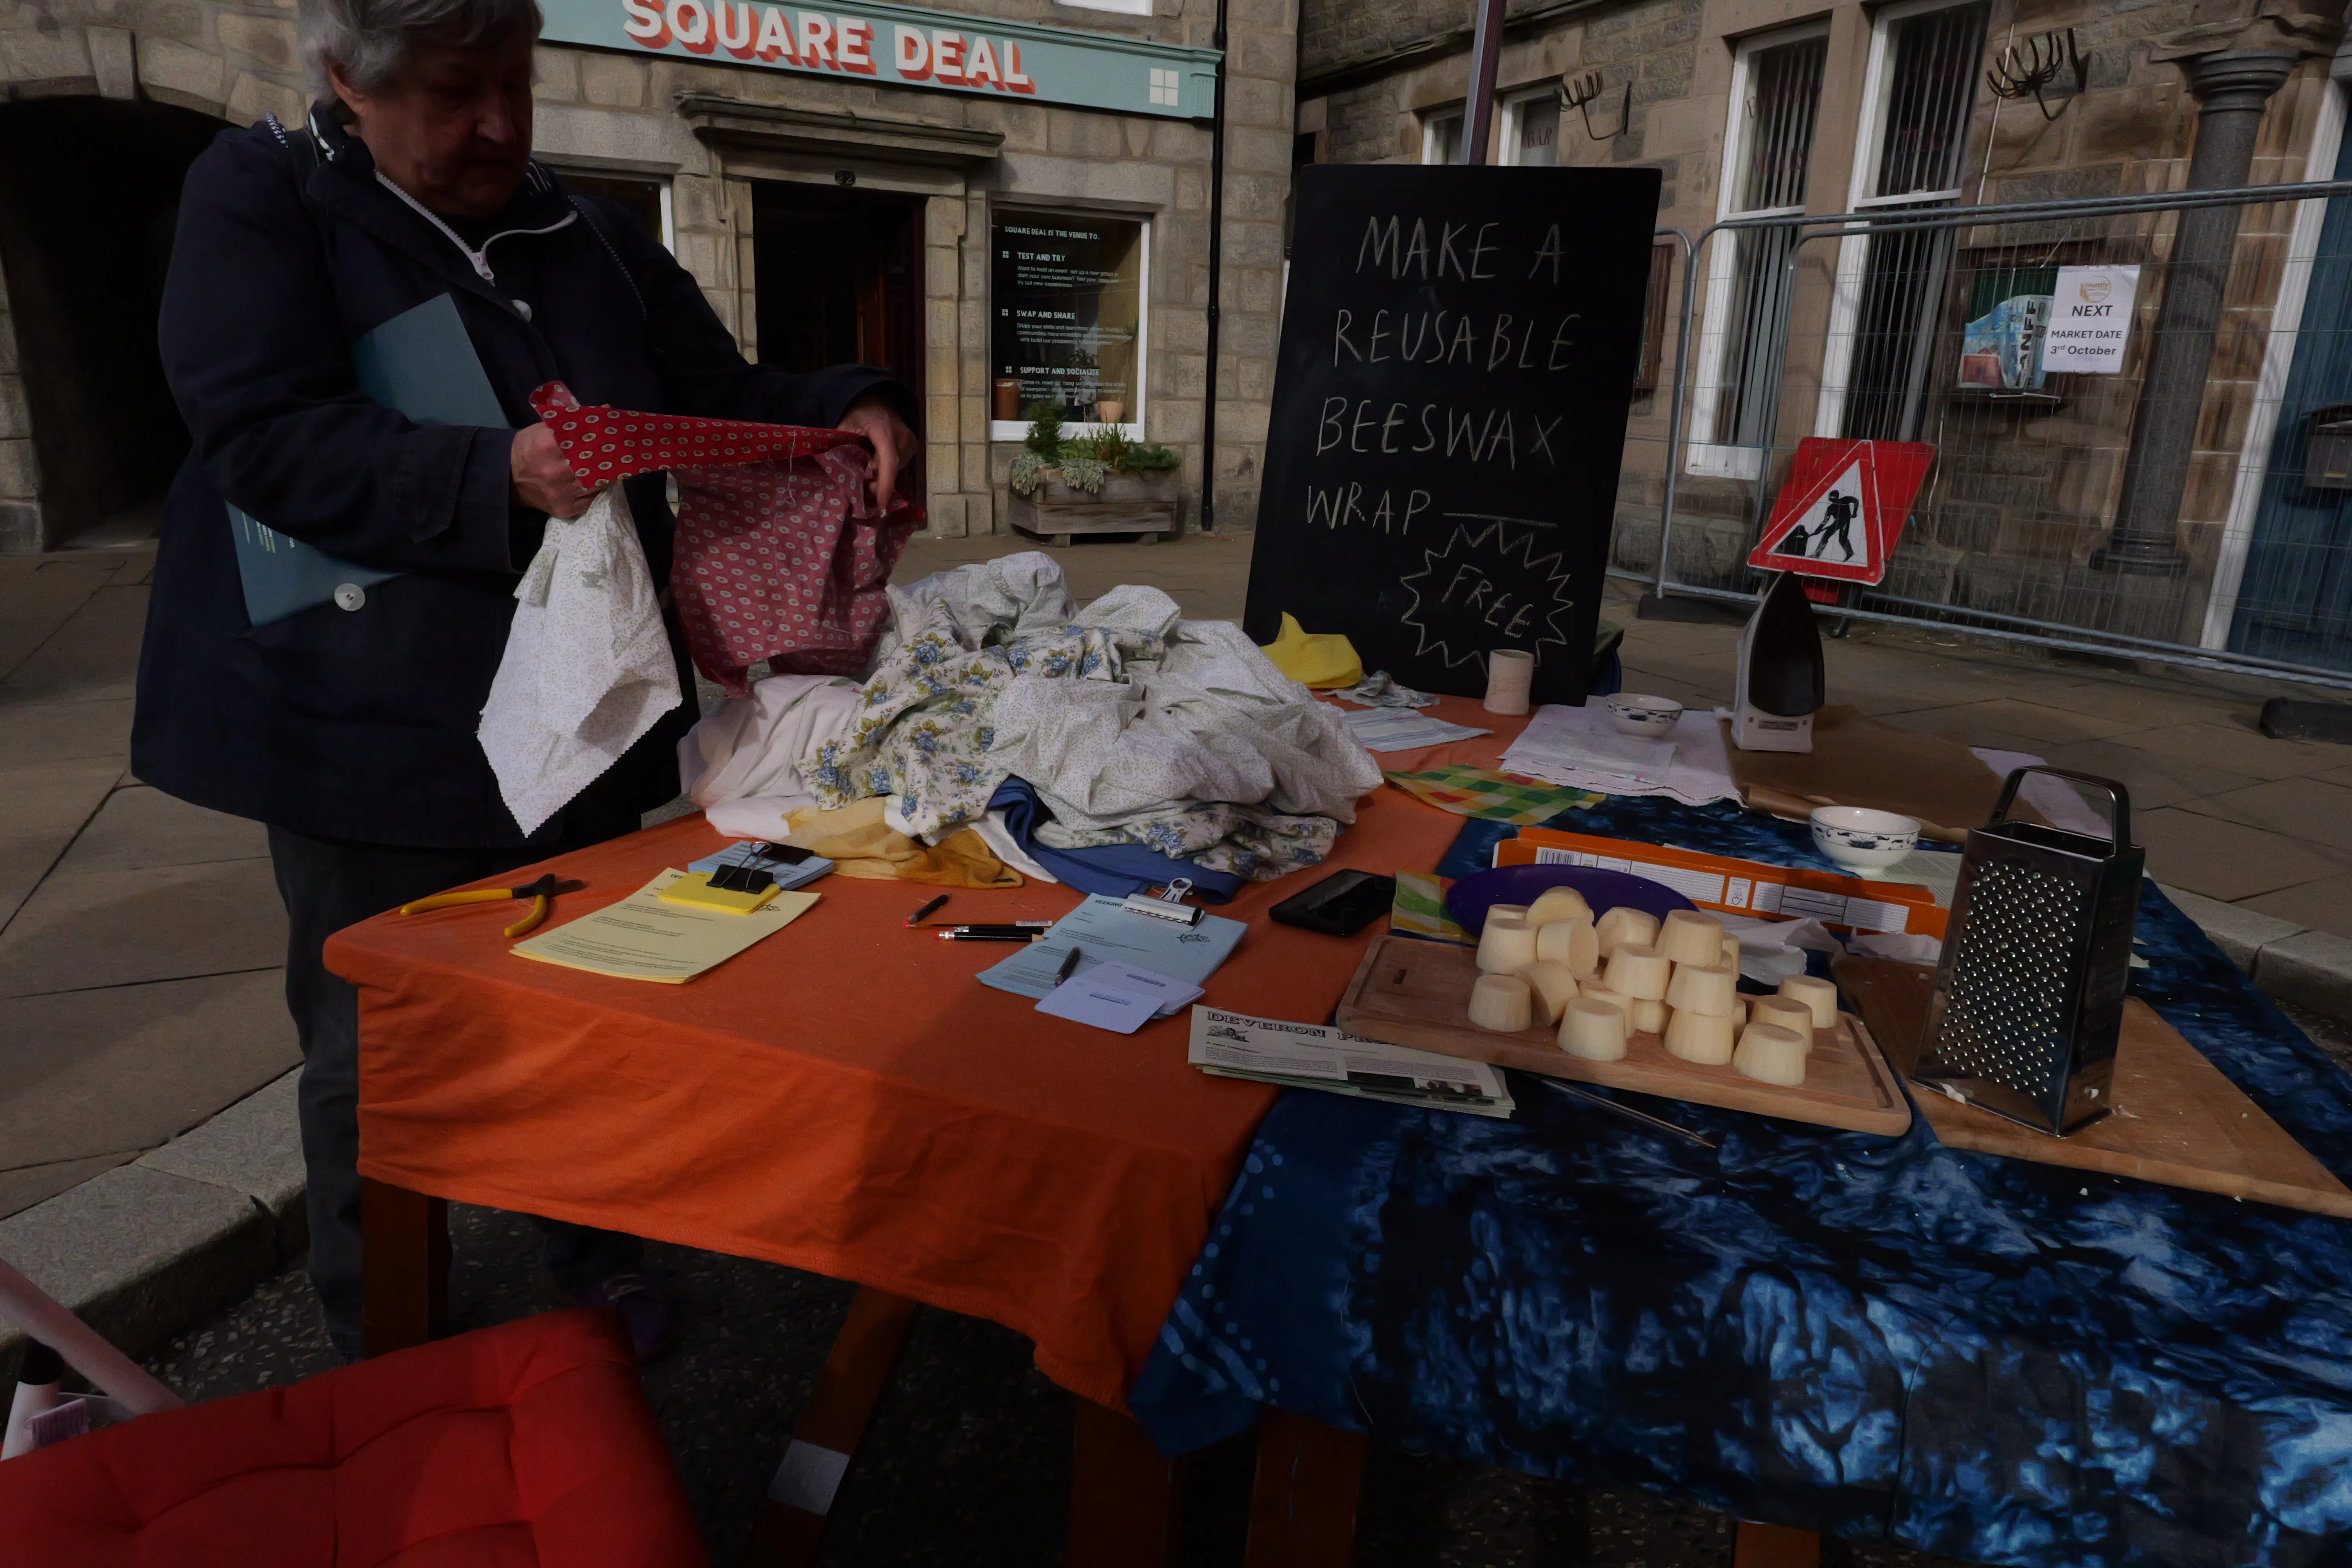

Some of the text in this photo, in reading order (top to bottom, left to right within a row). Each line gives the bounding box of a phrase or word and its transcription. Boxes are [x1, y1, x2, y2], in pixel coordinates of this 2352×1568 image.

[622, 0, 1035, 94] SQUARE DEAL
[1004, 226, 1030, 235] SQUARE
[1031, 228, 1046, 236] DEAL
[1055, 230, 1067, 238] THE
[1069, 231, 1087, 240] VENUE
[1017, 252, 1034, 260] TEST
[1357, 214, 1565, 285] MAKE A
[1053, 312, 1076, 320] SHARE
[2071, 305, 2114, 316] NEXT
[1334, 308, 1580, 372] REUSABLE
[2050, 345, 2116, 355] 3rd October
[1067, 368, 1099, 376] SOCIALISE
[1316, 396, 1564, 470] BEESWAX
[1307, 481, 1431, 536] WRAP
[1441, 564, 1534, 639] FREE
[1094, 899, 1123, 907] SEEKING
[1207, 1011, 1327, 1038] DEVERON
